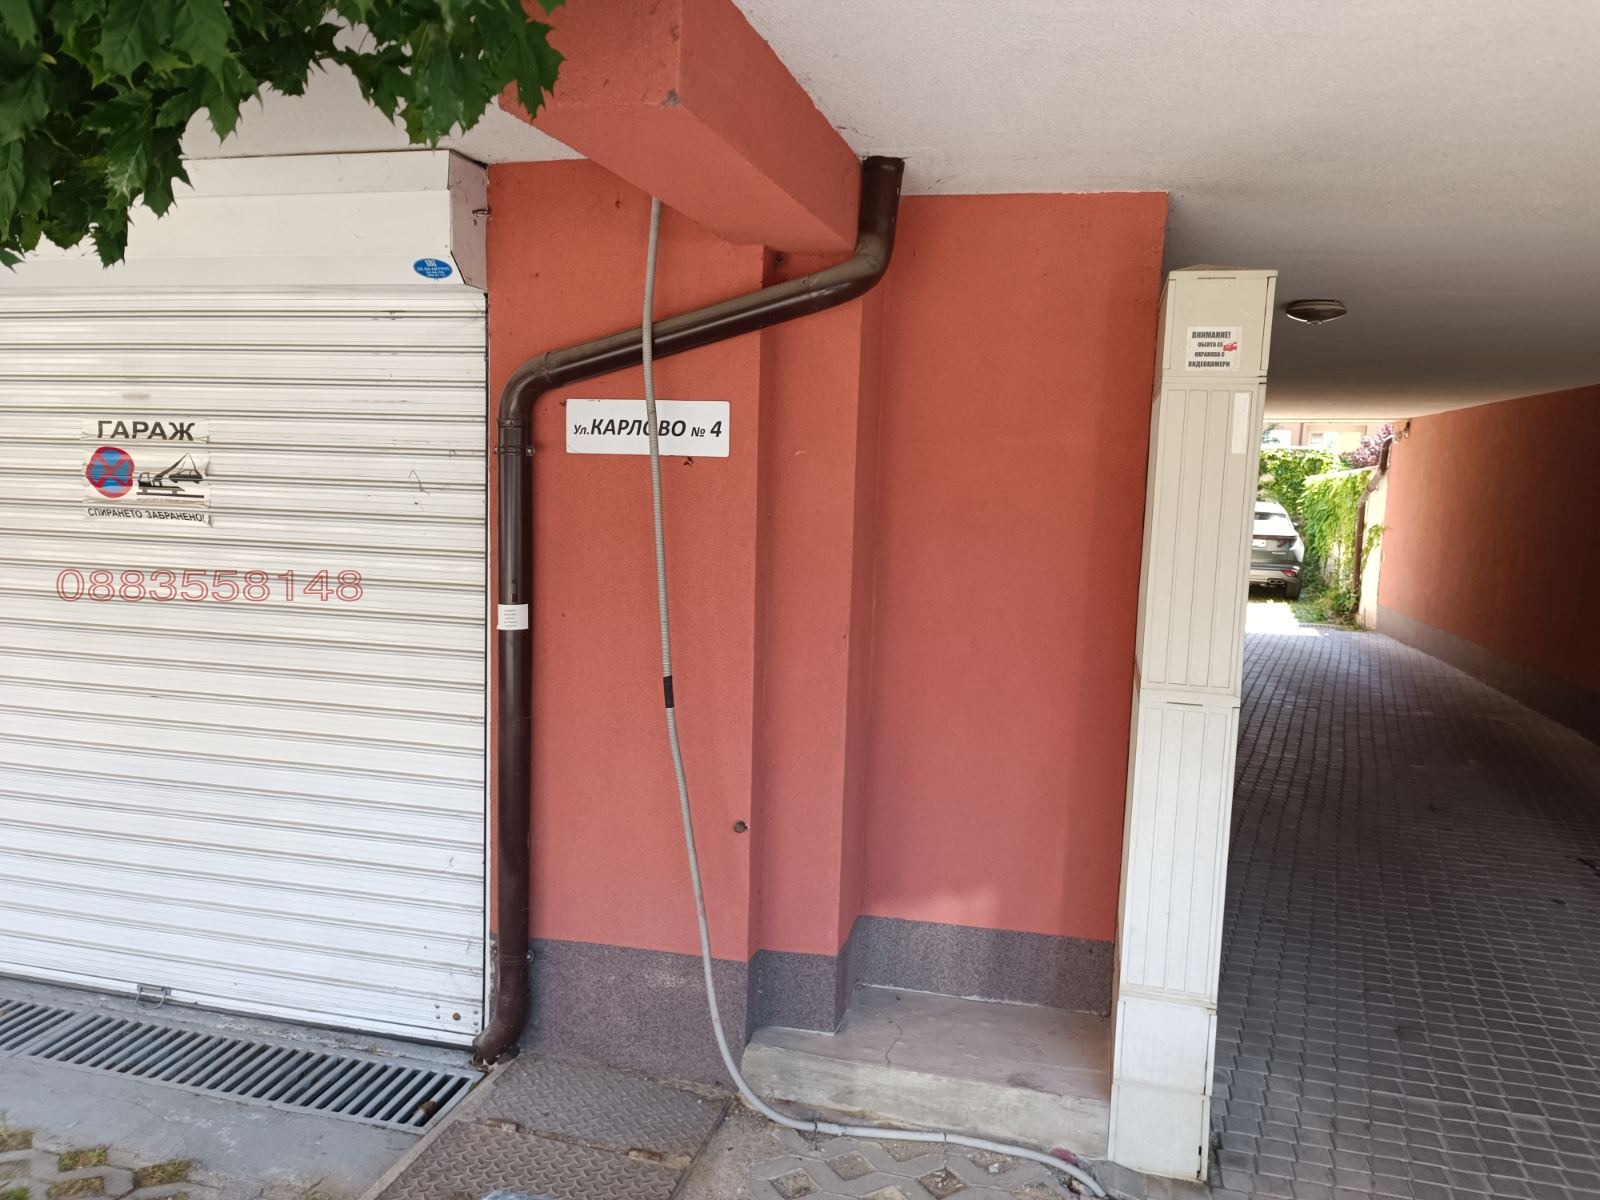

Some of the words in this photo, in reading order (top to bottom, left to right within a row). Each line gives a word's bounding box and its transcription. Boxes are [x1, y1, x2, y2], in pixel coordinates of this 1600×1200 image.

[96, 419, 195, 441] ГАРАЖ
[709, 420, 723, 438] 4
[87, 507, 143, 519] СПИРАНЕТО
[145, 510, 205, 522] ЗАБРАНЕНО!
[55, 568, 364, 602] 0883558148
